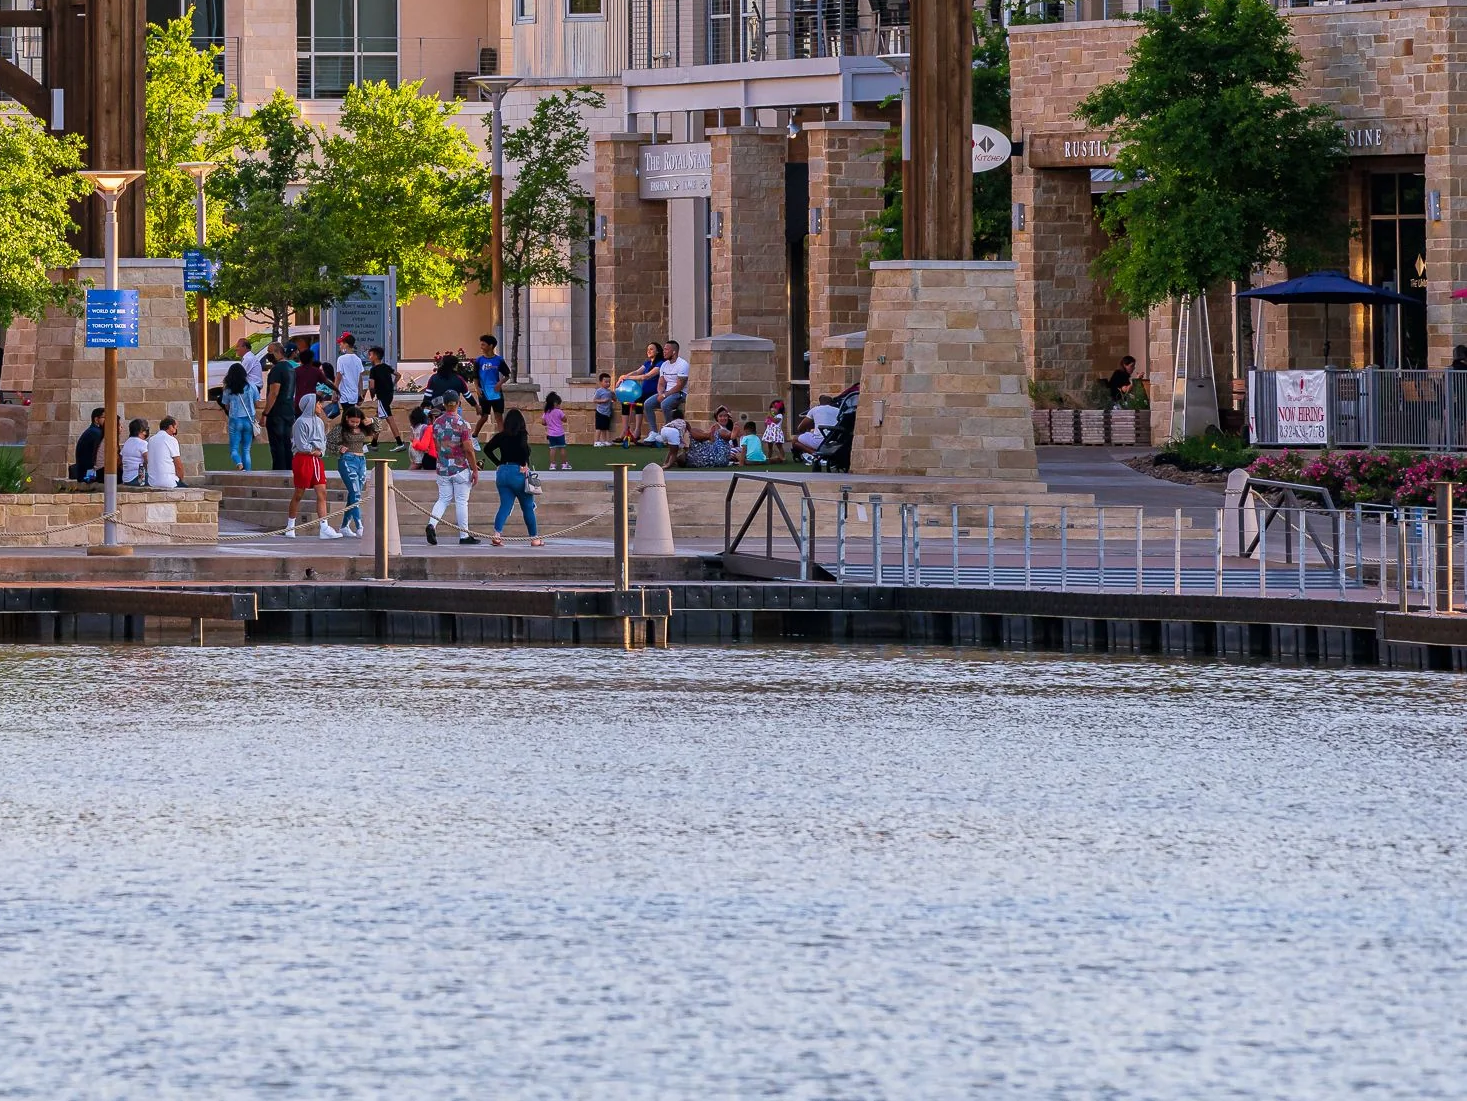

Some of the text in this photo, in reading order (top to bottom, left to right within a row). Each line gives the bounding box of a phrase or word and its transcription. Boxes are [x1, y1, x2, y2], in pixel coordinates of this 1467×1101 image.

[1348, 128, 1382, 147] SINE
[664, 151, 688, 171] ROYAL
[974, 153, 1006, 162] KITCHEN
[1278, 406, 1324, 422] NOW HIRING
